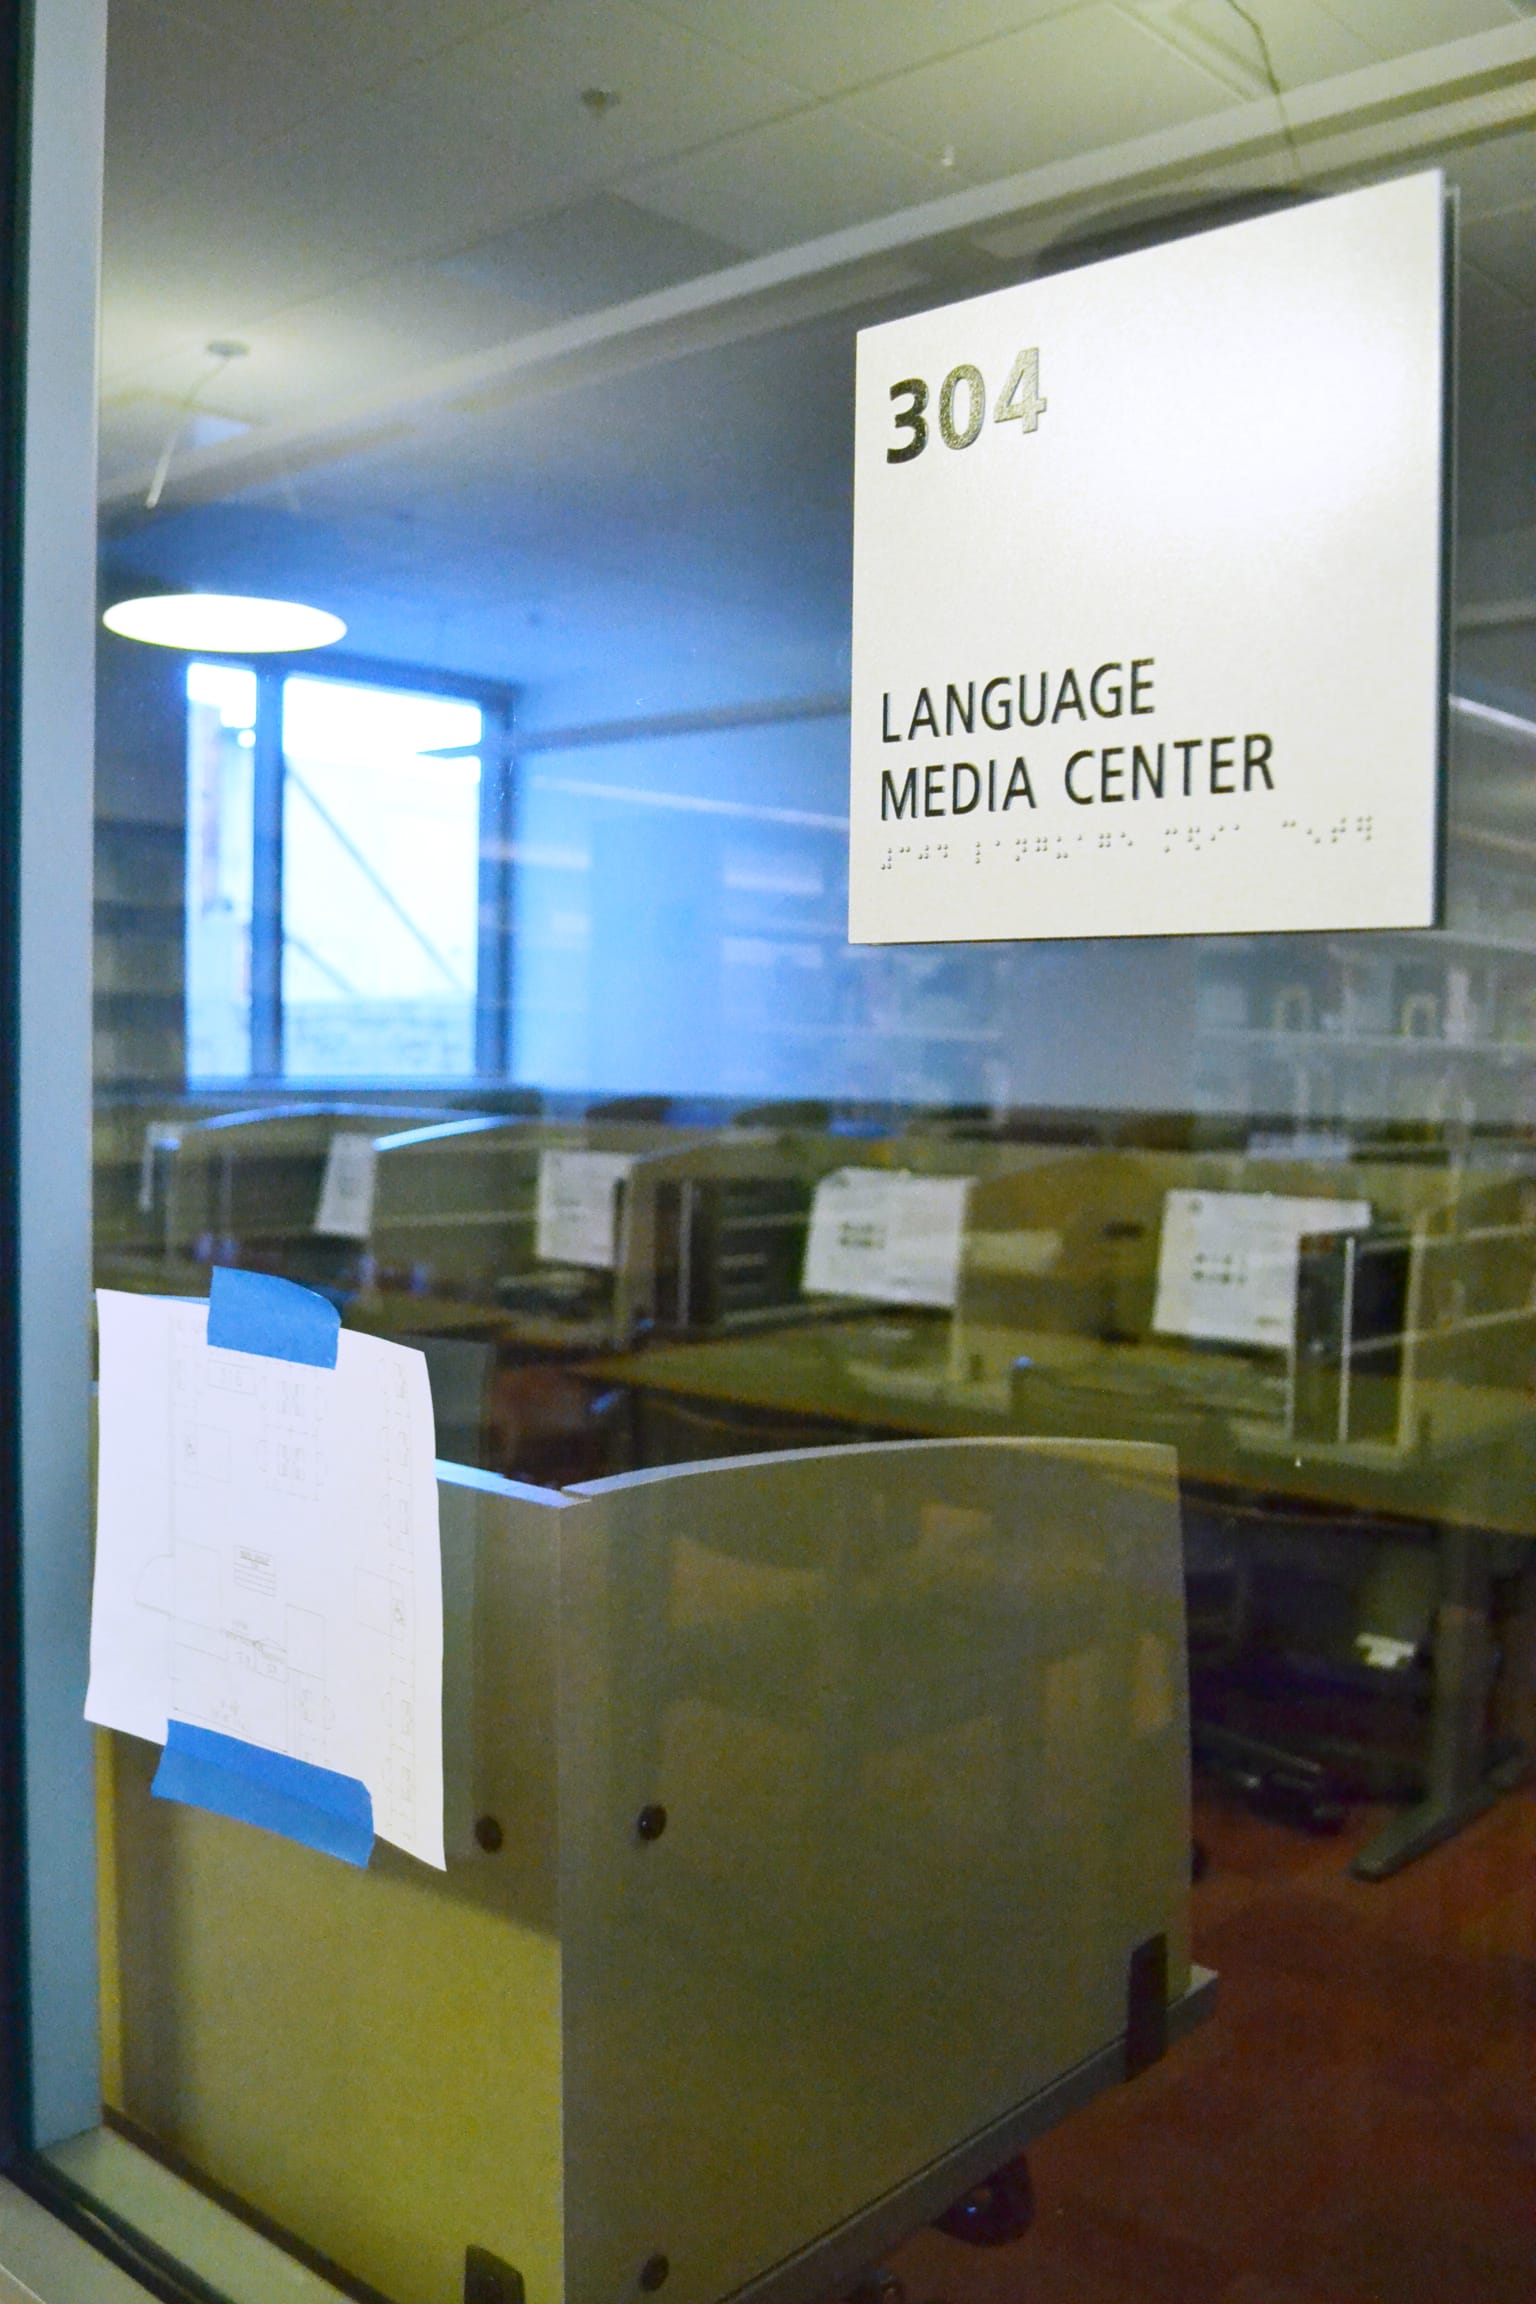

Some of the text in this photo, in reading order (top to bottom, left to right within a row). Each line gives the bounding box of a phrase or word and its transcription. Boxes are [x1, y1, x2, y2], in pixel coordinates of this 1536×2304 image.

[886, 346, 1048, 465] 304
[881, 656, 1156, 744] LANGUAGE
[880, 732, 1276, 822] MEDIA CENTER
